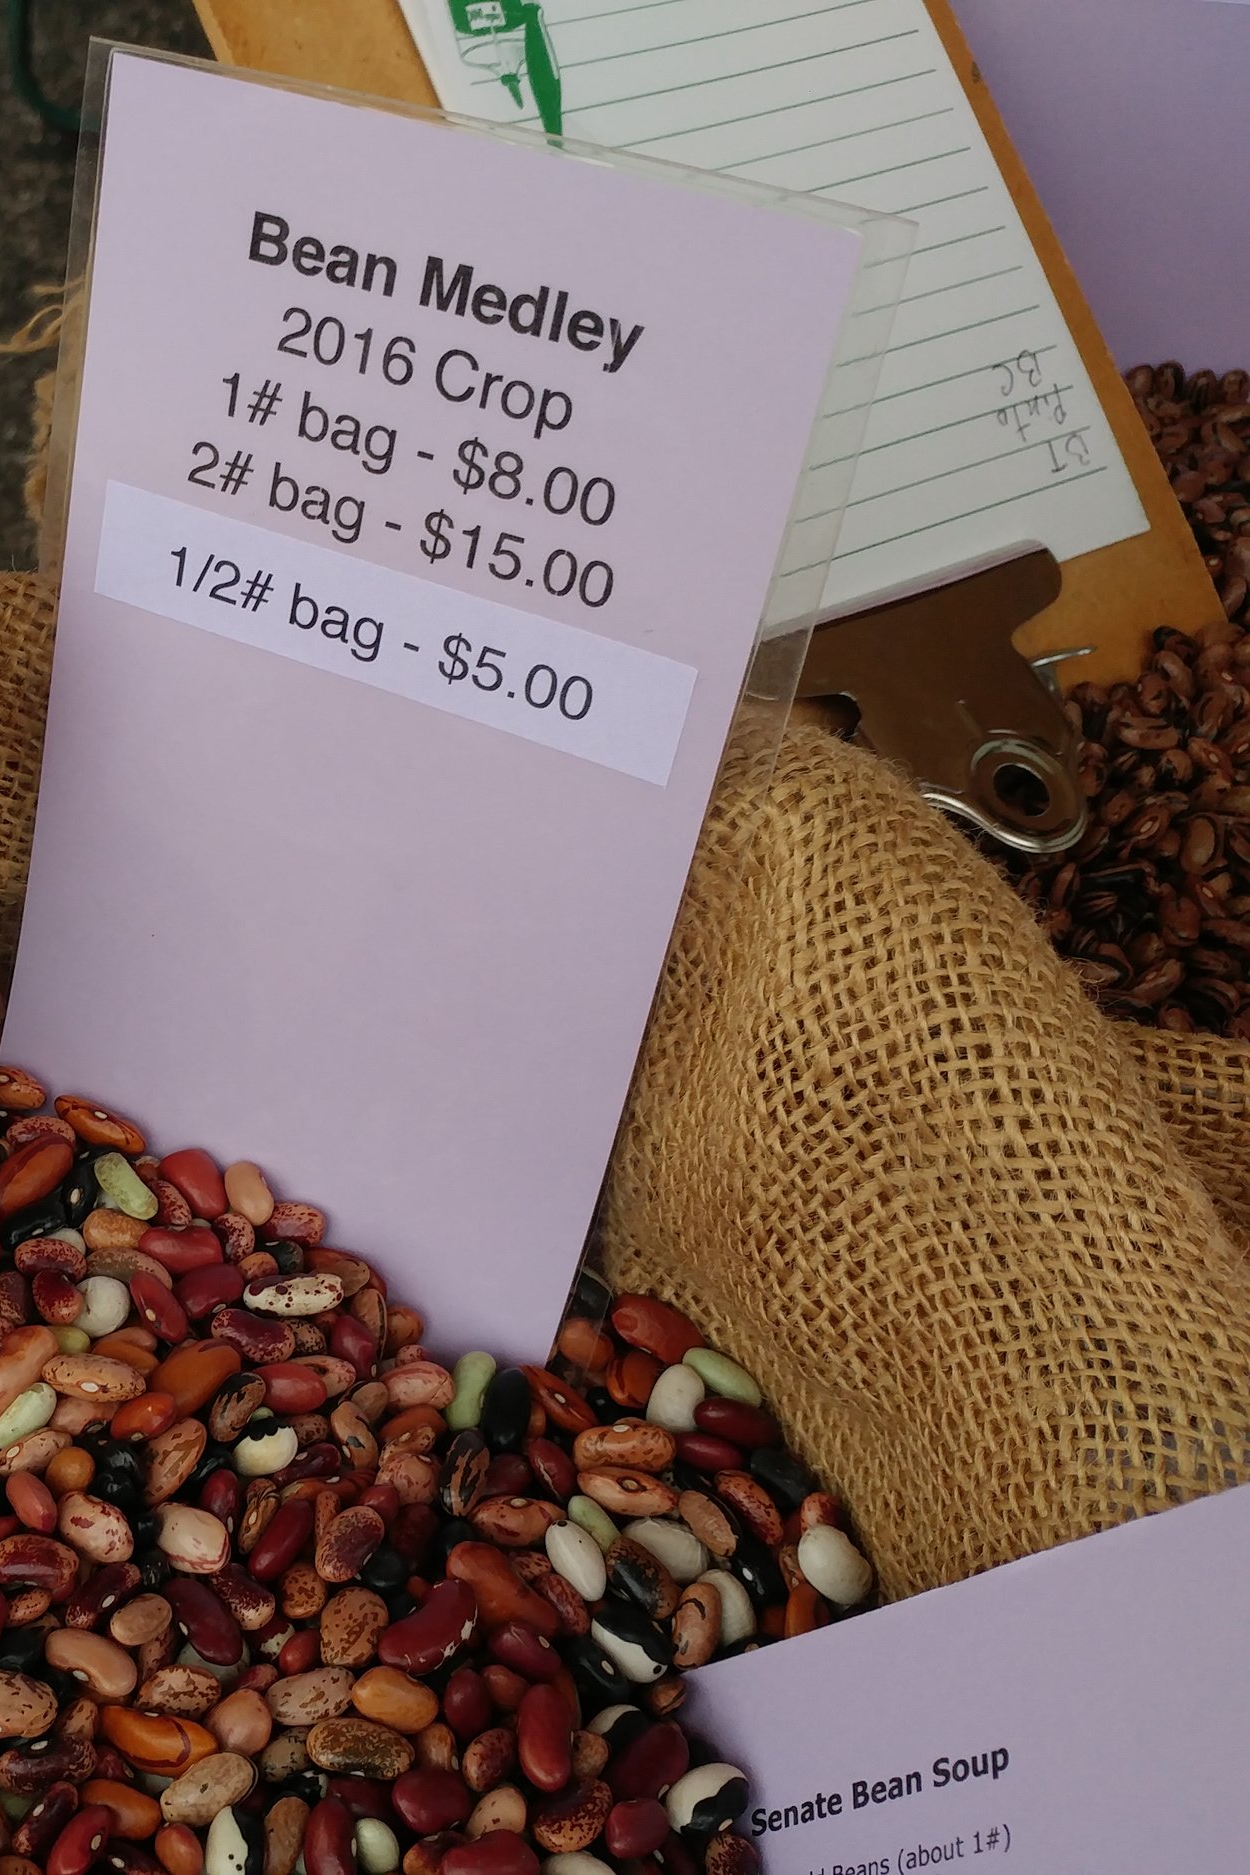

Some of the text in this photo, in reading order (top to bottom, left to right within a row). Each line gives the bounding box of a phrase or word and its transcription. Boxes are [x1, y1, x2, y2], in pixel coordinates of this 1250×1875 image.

[248, 211, 645, 374] Bean Medley
[220, 372, 283, 428] 1#
[297, 391, 399, 476] bag
[452, 436, 616, 528] $8.00
[276, 307, 574, 439] 2016 Crop
[187, 441, 254, 497] 2#
[268, 462, 366, 545] bag
[419, 508, 614, 609] $15.00
[169, 546, 274, 613] 1/2#
[288, 583, 385, 664] bag
[437, 632, 594, 722] $5.00
[750, 1747, 1010, 1837] Senate Bean Soup
[897, 1836, 965, 1875] (about
[972, 1823, 1012, 1854] 1#)
